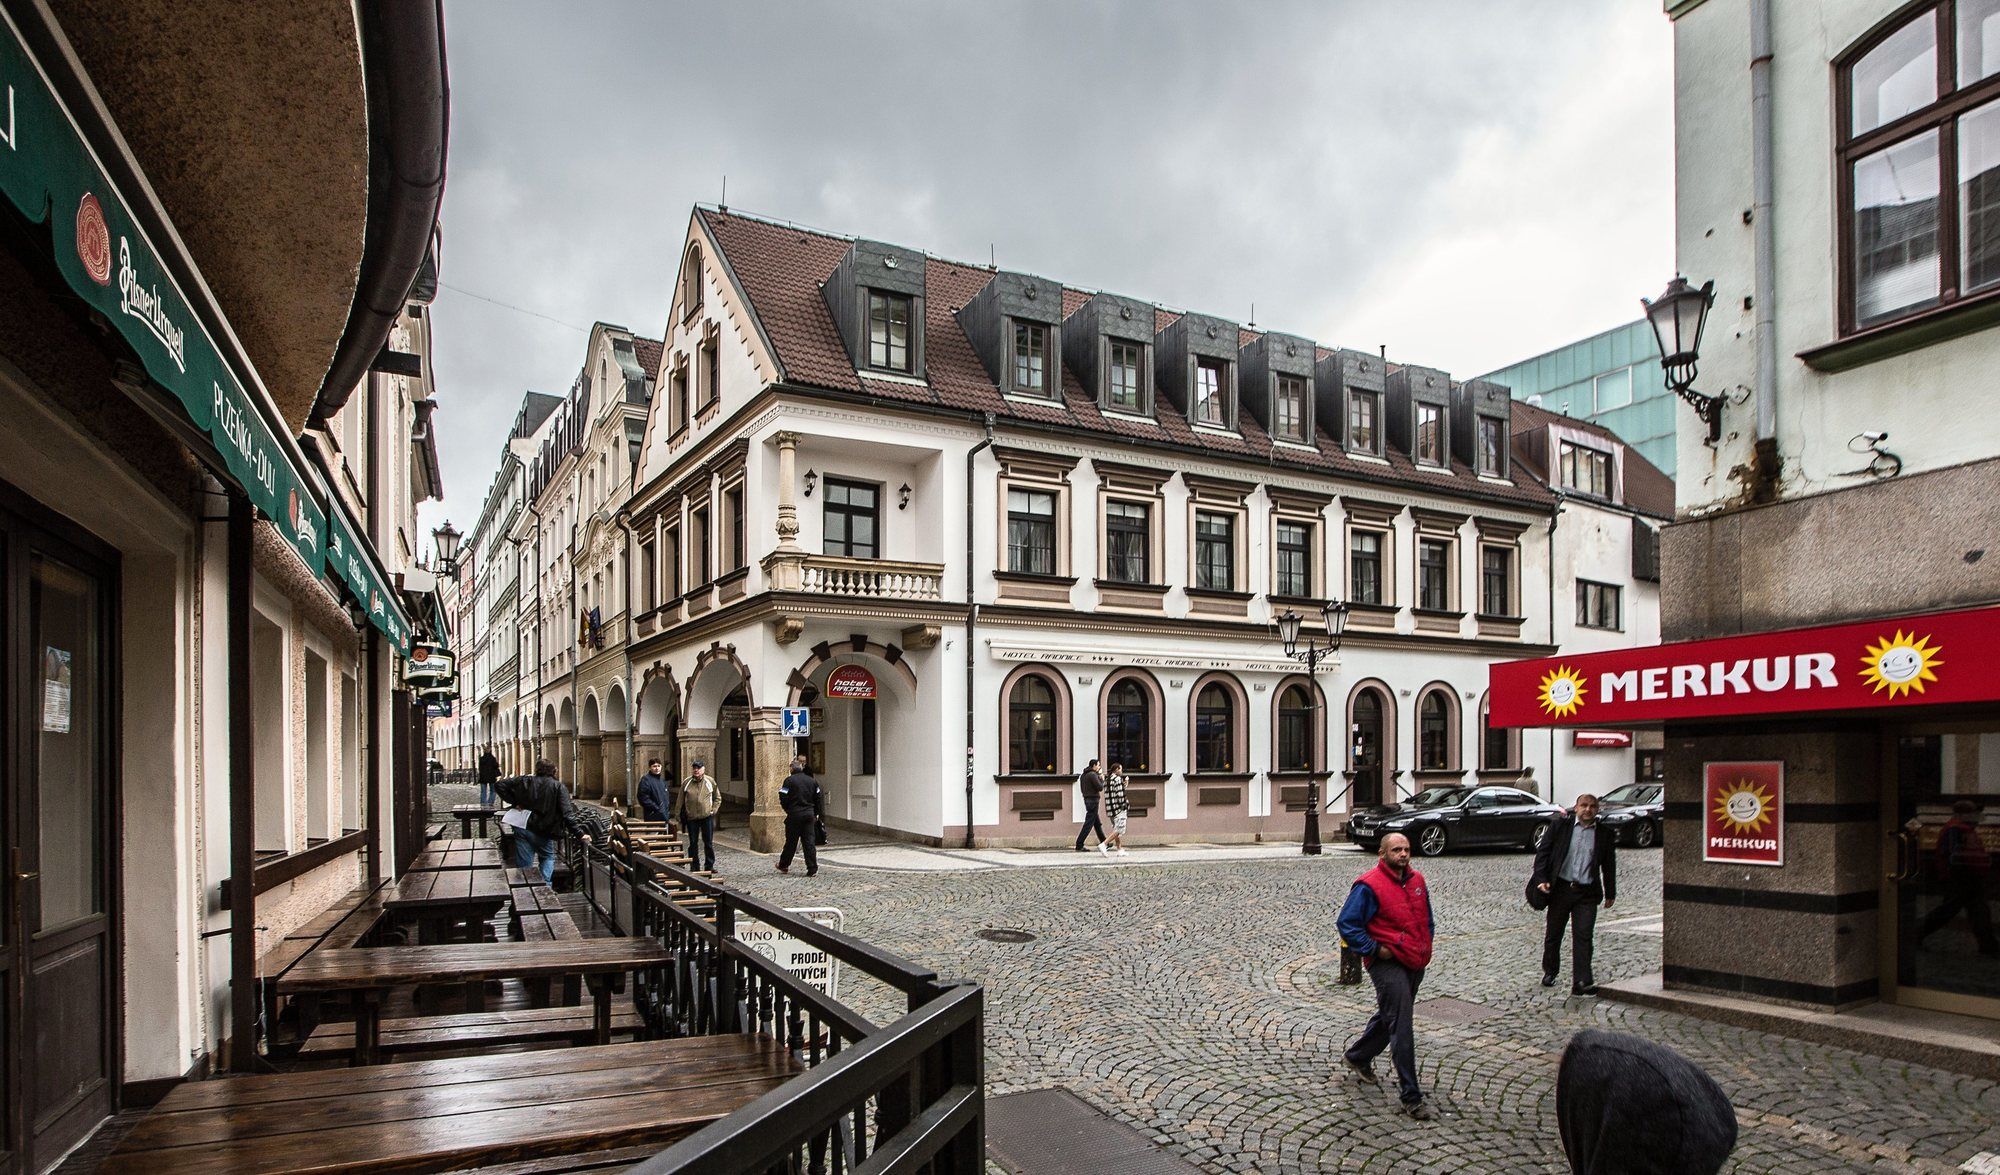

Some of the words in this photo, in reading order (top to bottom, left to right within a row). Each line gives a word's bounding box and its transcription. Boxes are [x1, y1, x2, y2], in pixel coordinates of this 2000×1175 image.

[119, 236, 155, 320] Pilsner
[153, 284, 185, 366] Urquell
[1003, 651, 1037, 659] HOTEL
[1040, 653, 1083, 662] RADNICE
[1131, 657, 1162, 665] HOTEL
[1164, 659, 1202, 667] RADNICE
[1601, 652, 1839, 704] MERKUR
[1711, 837, 1777, 850] MERKUR
[741, 928, 773, 941] VÍNO
[791, 952, 827, 965] PRODEJ
